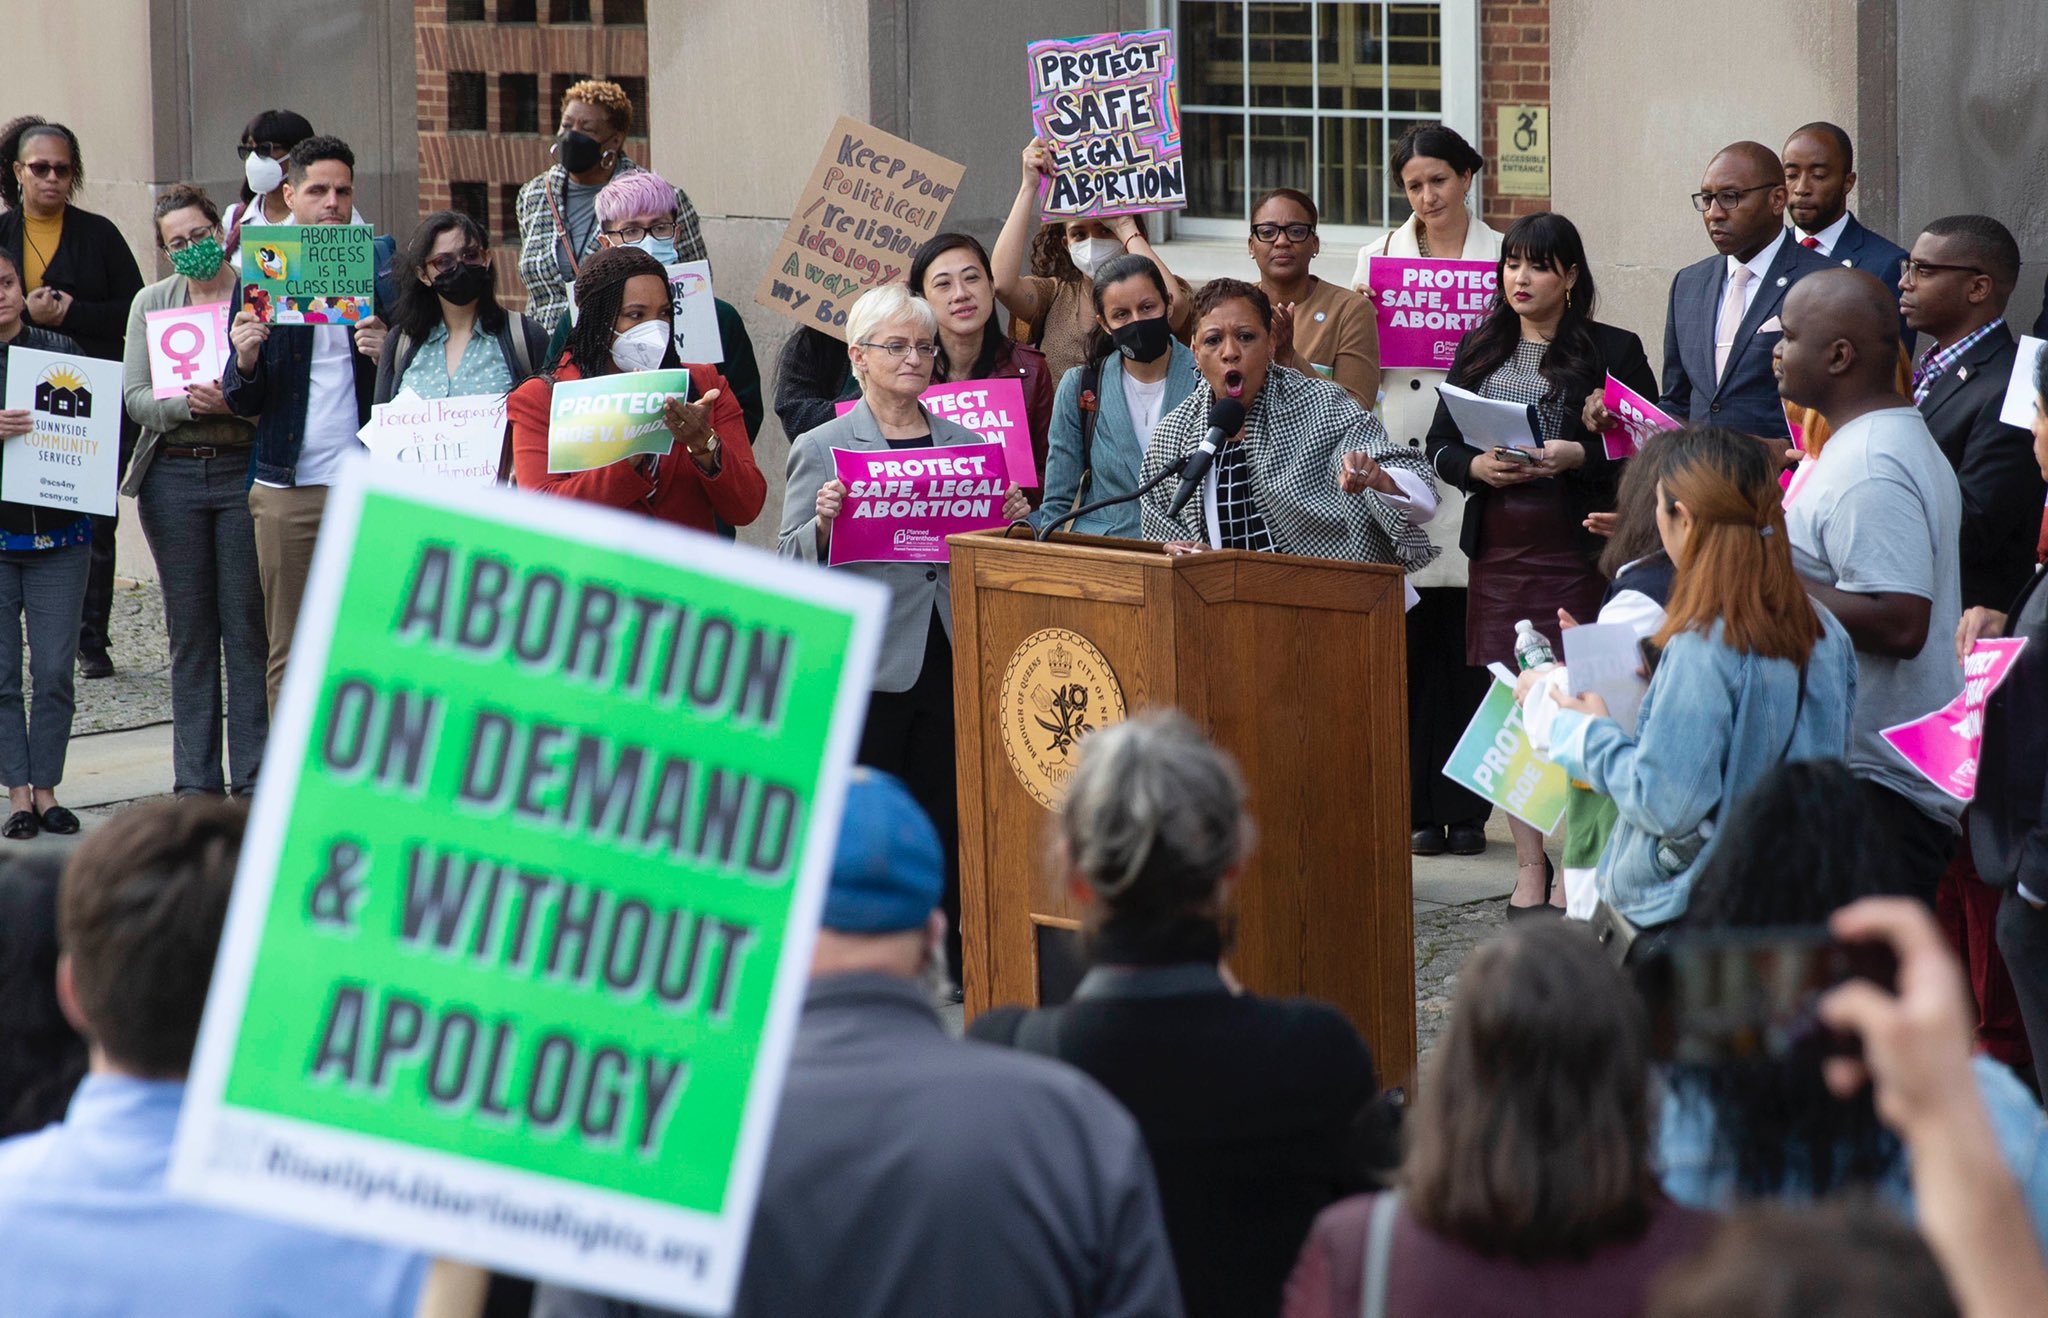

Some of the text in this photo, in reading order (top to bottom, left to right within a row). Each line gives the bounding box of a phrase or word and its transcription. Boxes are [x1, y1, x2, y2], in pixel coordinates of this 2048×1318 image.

[1040, 44, 1161, 87] PROTECT
[1049, 86, 1151, 136] SAFE
[1052, 135, 1150, 169] LEGAL
[1501, 155, 1546, 164] ACCESSIBLE
[836, 133, 954, 203] Keep your
[1502, 165, 1544, 173] ENTRANCE
[1050, 160, 1184, 209] ABORTION
[822, 166, 938, 231] Political
[301, 227, 373, 244] ABORTION
[802, 196, 926, 259] /religiou
[308, 246, 366, 263] ACCESS
[797, 224, 902, 287] ideology
[318, 264, 347, 277] IS A
[1402, 268, 1498, 290] PROTEC
[285, 280, 373, 295] CLASS ISSUE
[770, 279, 849, 326] my Bo
[1381, 289, 1450, 312] SAFE,
[1390, 310, 1484, 330] ABORT
[437, 400, 506, 428] Pregnancy
[919, 390, 988, 415] TECT
[36, 419, 87, 437] SUNNYSIDE
[947, 410, 1014, 429] EGAL
[24, 432, 98, 456] COMMUNITY
[413, 432, 424, 444] is
[38, 450, 82, 466] SERVICES
[867, 456, 986, 478] PROTECT
[40, 477, 75, 490] @scs4ny
[848, 479, 1005, 500] SAFE, LEGAL
[40, 491, 78, 504] scsny.org
[852, 499, 991, 519] ABORTION
[398, 546, 793, 725] ABORTION
[1077, 660, 1096, 683] CITY
[1094, 686, 1104, 701] OF
[1017, 657, 1042, 760] BOROUGH OF QUEENS
[1471, 704, 1525, 793] PROT
[321, 678, 798, 877] ON DEMAND
[1506, 760, 1543, 812] ROE
[311, 842, 755, 1013] & WITHOUT
[313, 986, 685, 1150] APOLOGY
